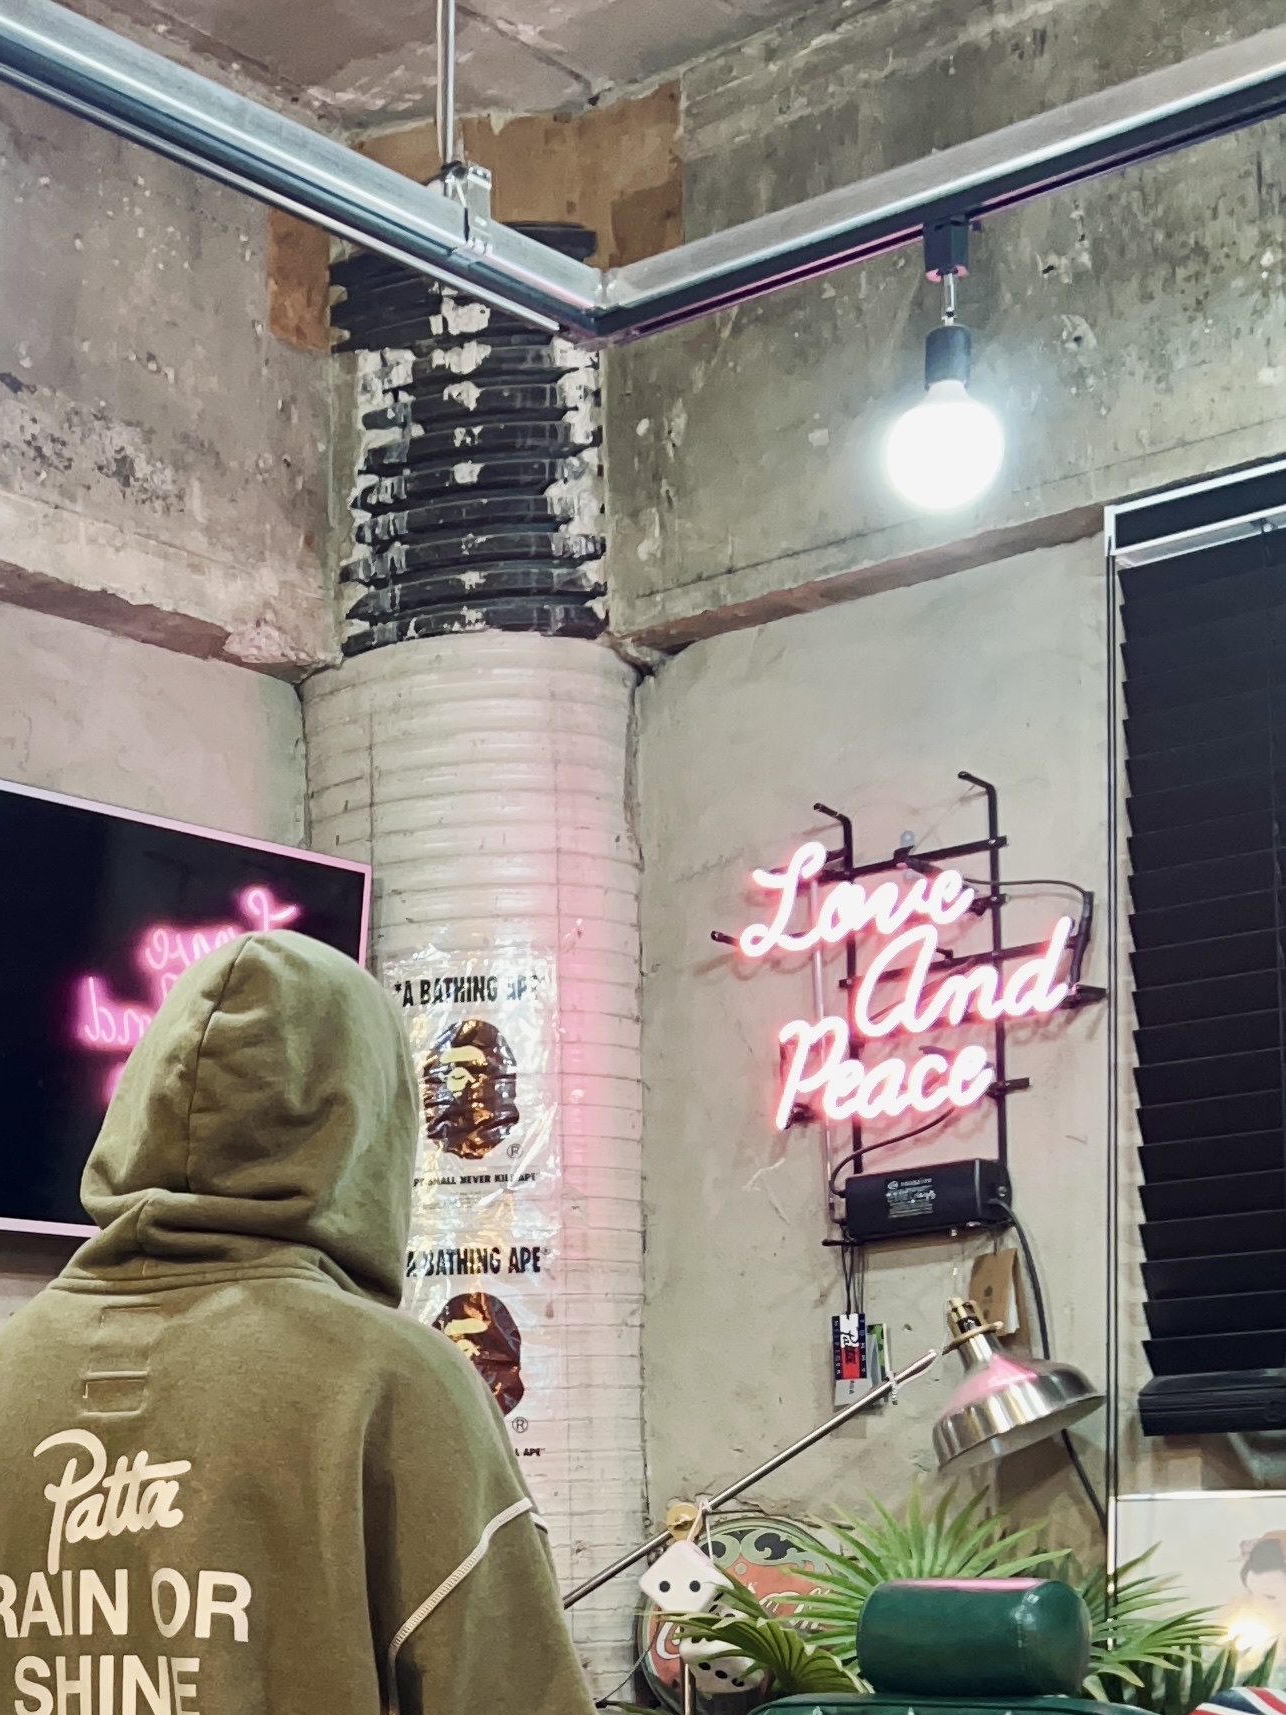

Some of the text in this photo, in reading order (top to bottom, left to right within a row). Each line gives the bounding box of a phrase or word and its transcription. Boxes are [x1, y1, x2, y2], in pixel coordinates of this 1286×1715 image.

[739, 841, 975, 958] Love
[420, 975, 498, 1005] BATHING
[855, 916, 1077, 1037] And
[776, 1016, 994, 1130] Peace
[460, 1174, 491, 1184] NEVER
[424, 1247, 502, 1277] BATHING
[33, 1428, 191, 1575] Patta
[151, 1567, 252, 1642] OR
